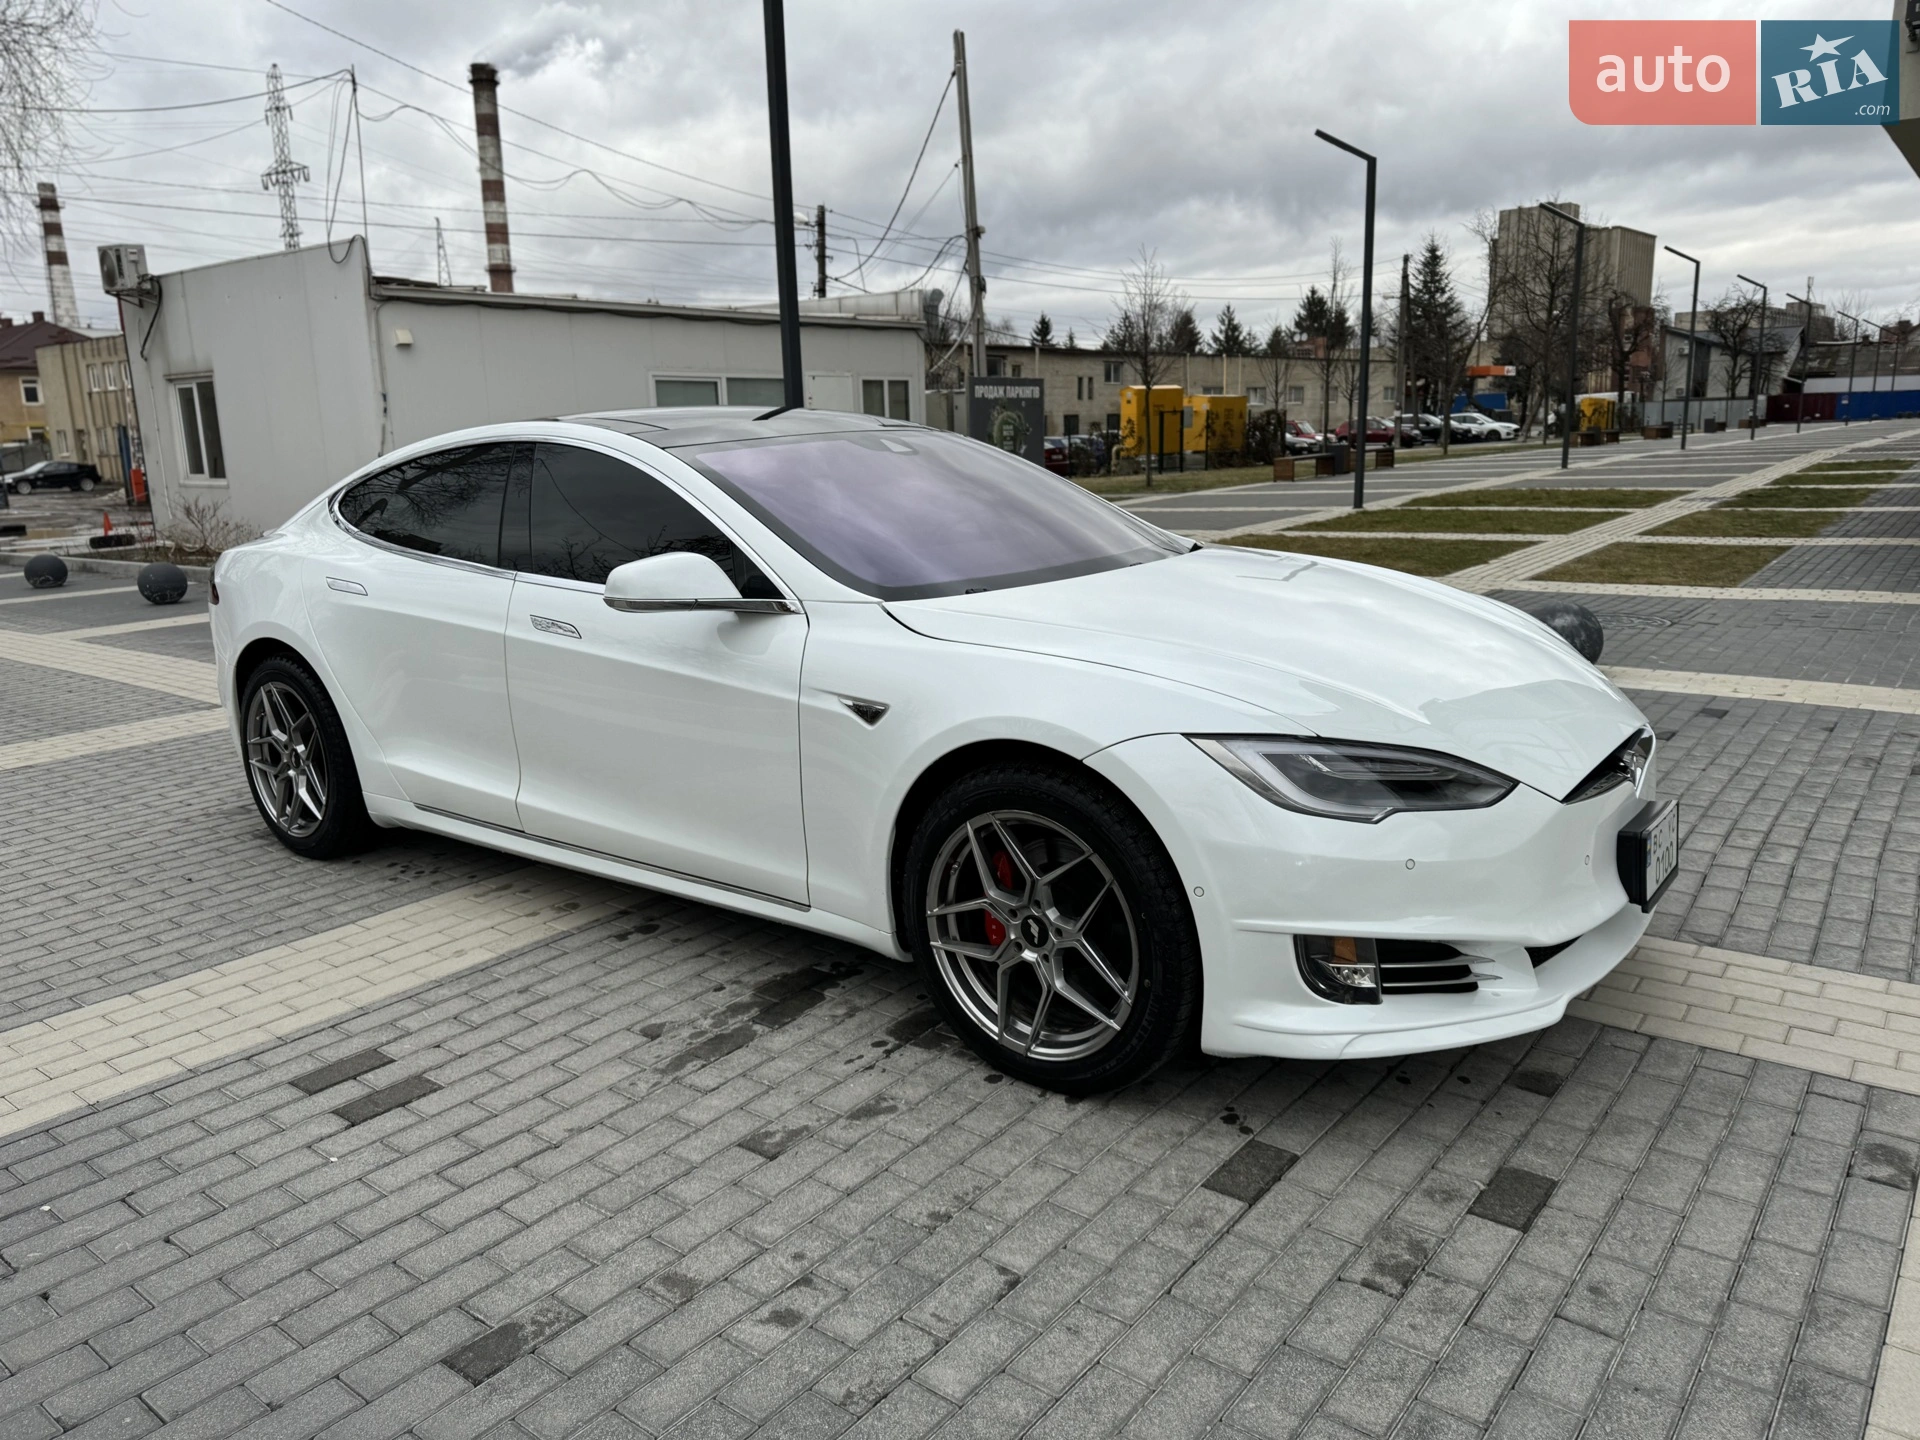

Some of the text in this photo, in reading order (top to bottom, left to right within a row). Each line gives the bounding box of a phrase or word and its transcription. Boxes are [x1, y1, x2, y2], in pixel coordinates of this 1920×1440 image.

[974, 385, 1040, 399] ПРОДАЖ ПАРКІНГІВ
[1653, 829, 1663, 855] BC
[1655, 840, 1674, 885] 0100
